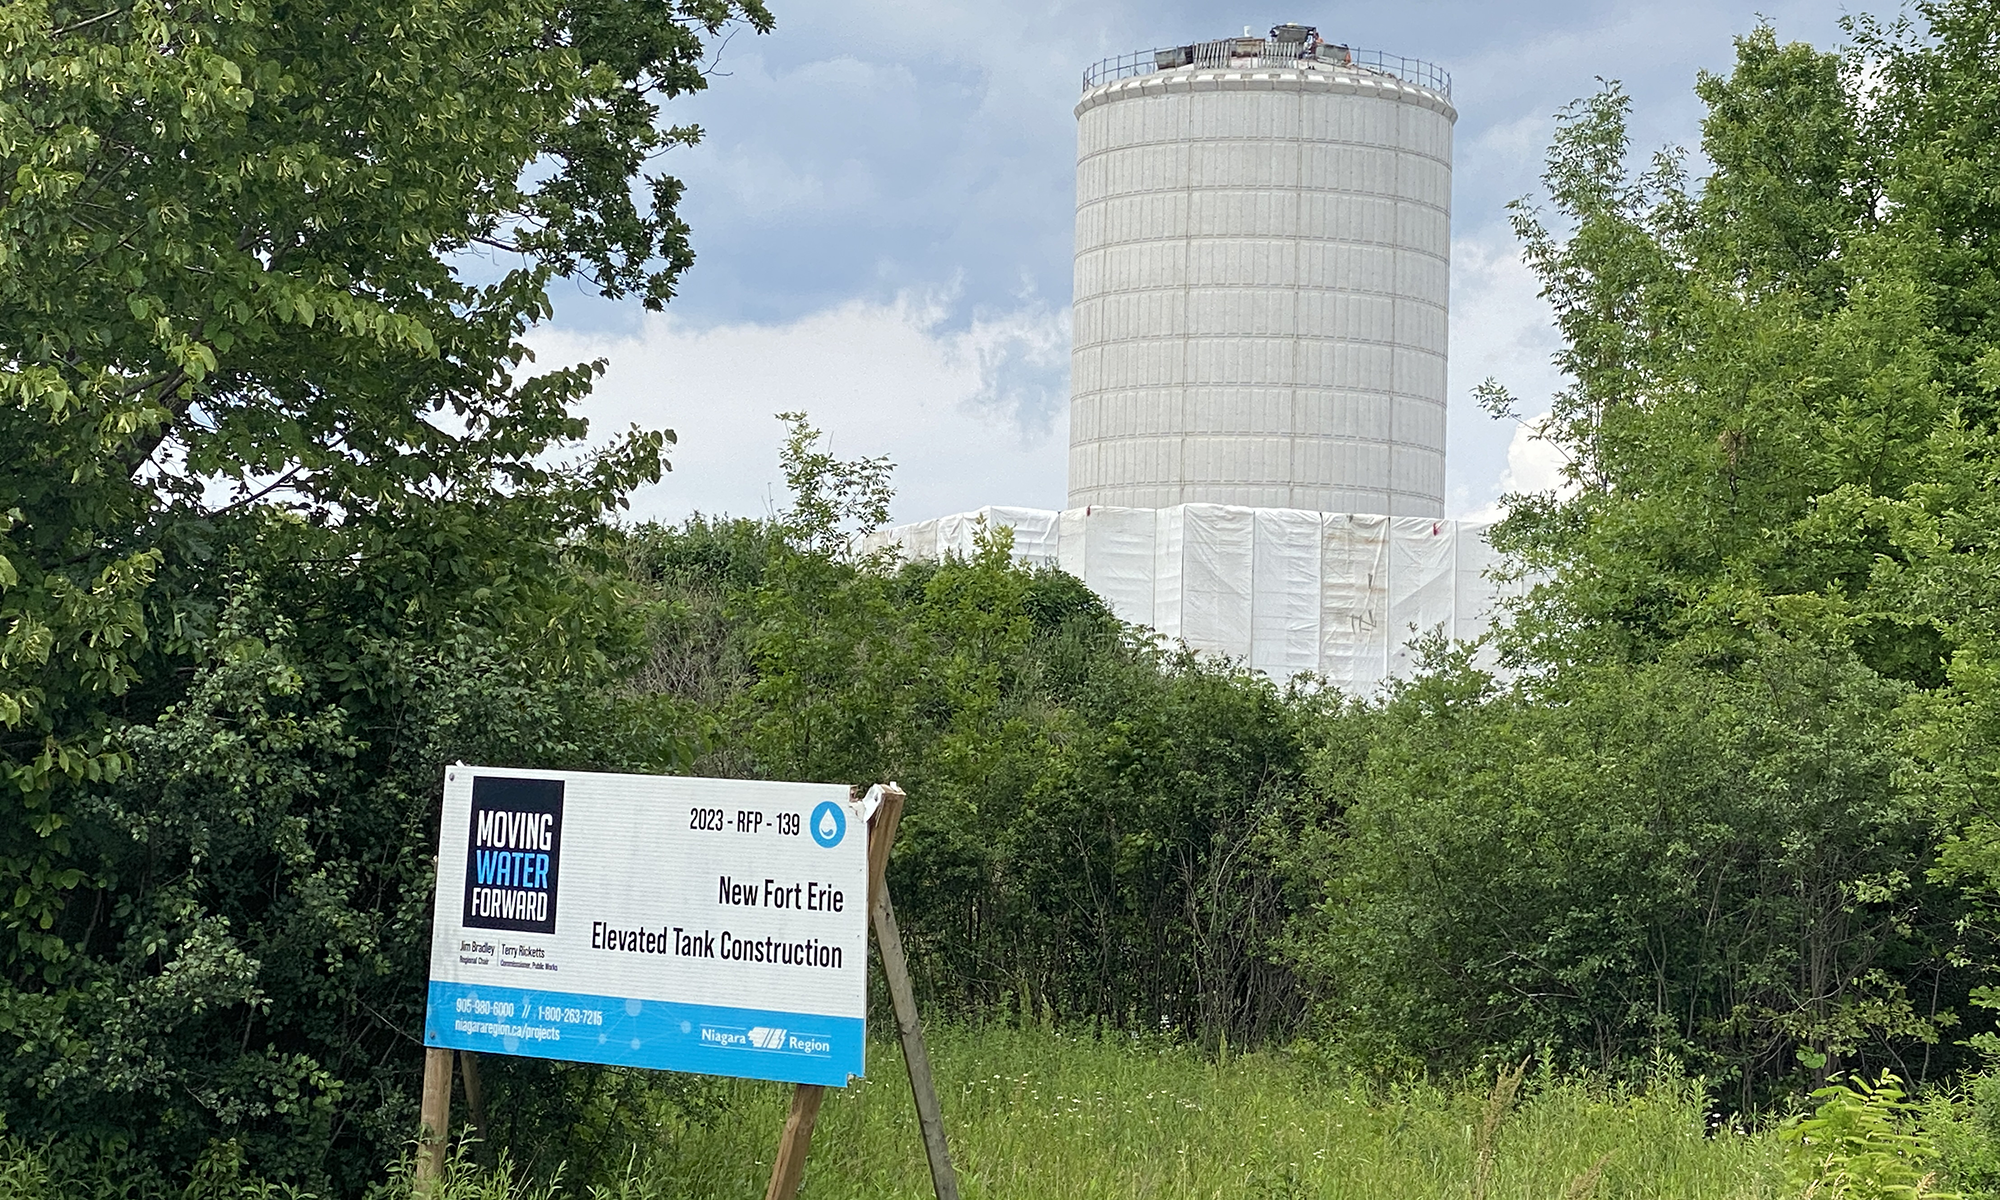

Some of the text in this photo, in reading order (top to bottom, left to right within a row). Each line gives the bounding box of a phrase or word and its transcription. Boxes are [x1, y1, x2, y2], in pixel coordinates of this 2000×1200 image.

[476, 809, 554, 851] MOVING
[690, 808, 724, 832] 2023
[737, 810, 763, 833] RFP
[776, 812, 801, 836] 139
[476, 849, 550, 889] WATER
[471, 887, 548, 922] FORWARD
[719, 875, 844, 913] New Fort Erie
[460, 940, 496, 957] Jim Bradley
[501, 943, 546, 959] Terry Ricketts
[591, 920, 843, 969] Elevated Tank Construction
[455, 998, 515, 1018] 905-980-6000
[538, 1005, 603, 1026] 1-800-263-7215
[454, 1017, 561, 1042] niagararegion.ca/projects
[701, 1028, 830, 1054] Niagara Region
